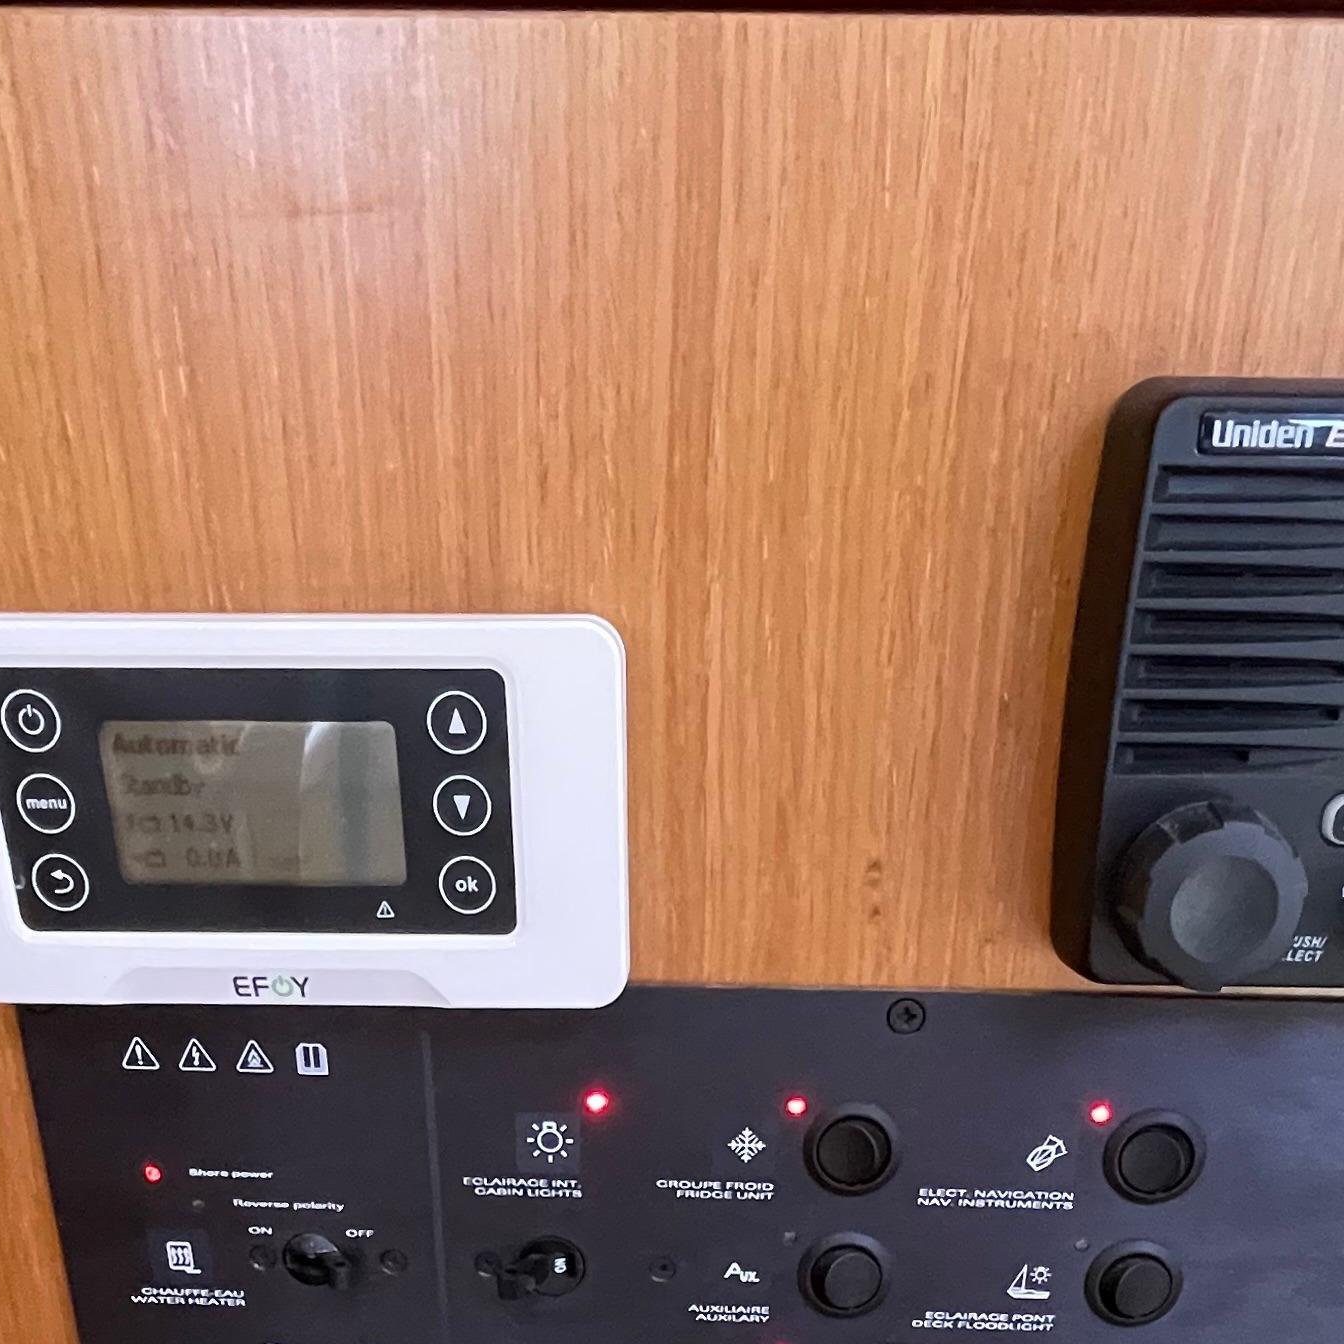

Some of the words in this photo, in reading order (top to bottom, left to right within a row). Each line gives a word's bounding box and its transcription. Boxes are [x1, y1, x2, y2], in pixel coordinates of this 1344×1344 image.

[1212, 419, 1312, 449] Uniden
[26, 798, 67, 811] menu
[455, 876, 478, 892] ok
[1293, 936, 1328, 948] USH/
[1282, 950, 1324, 962] LECT
[189, 1168, 229, 1177] Shore
[232, 1170, 273, 1179] power
[463, 1177, 549, 1188] ECLAIRAGE
[656, 1179, 721, 1190] GROUPE
[725, 1181, 774, 1192] FROID
[475, 1187, 524, 1197] CABIN
[527, 1188, 582, 1198] LIGHTS
[676, 1189, 733, 1200] FRIDGE
[737, 1191, 774, 1201] UNIT
[975, 1190, 1075, 1201] NAVIGATION
[232, 1198, 289, 1208] Reverse
[293, 1201, 344, 1212] polarity
[958, 1198, 1075, 1211] INSTRUMENTS
[248, 1226, 273, 1235] ON
[345, 1228, 374, 1239] OFF
[141, 1287, 244, 1298] CHAUFFE-EAU
[131, 1295, 186, 1305] WATER
[188, 1297, 246, 1306] HEATER
[688, 1304, 769, 1314] AUXILIAIRE
[925, 1311, 1009, 1321] ECLAIRAGE
[1012, 1313, 1056, 1323] PONT
[911, 1320, 954, 1329] DECK
[957, 1321, 1054, 1332] FLOODLIGHT
